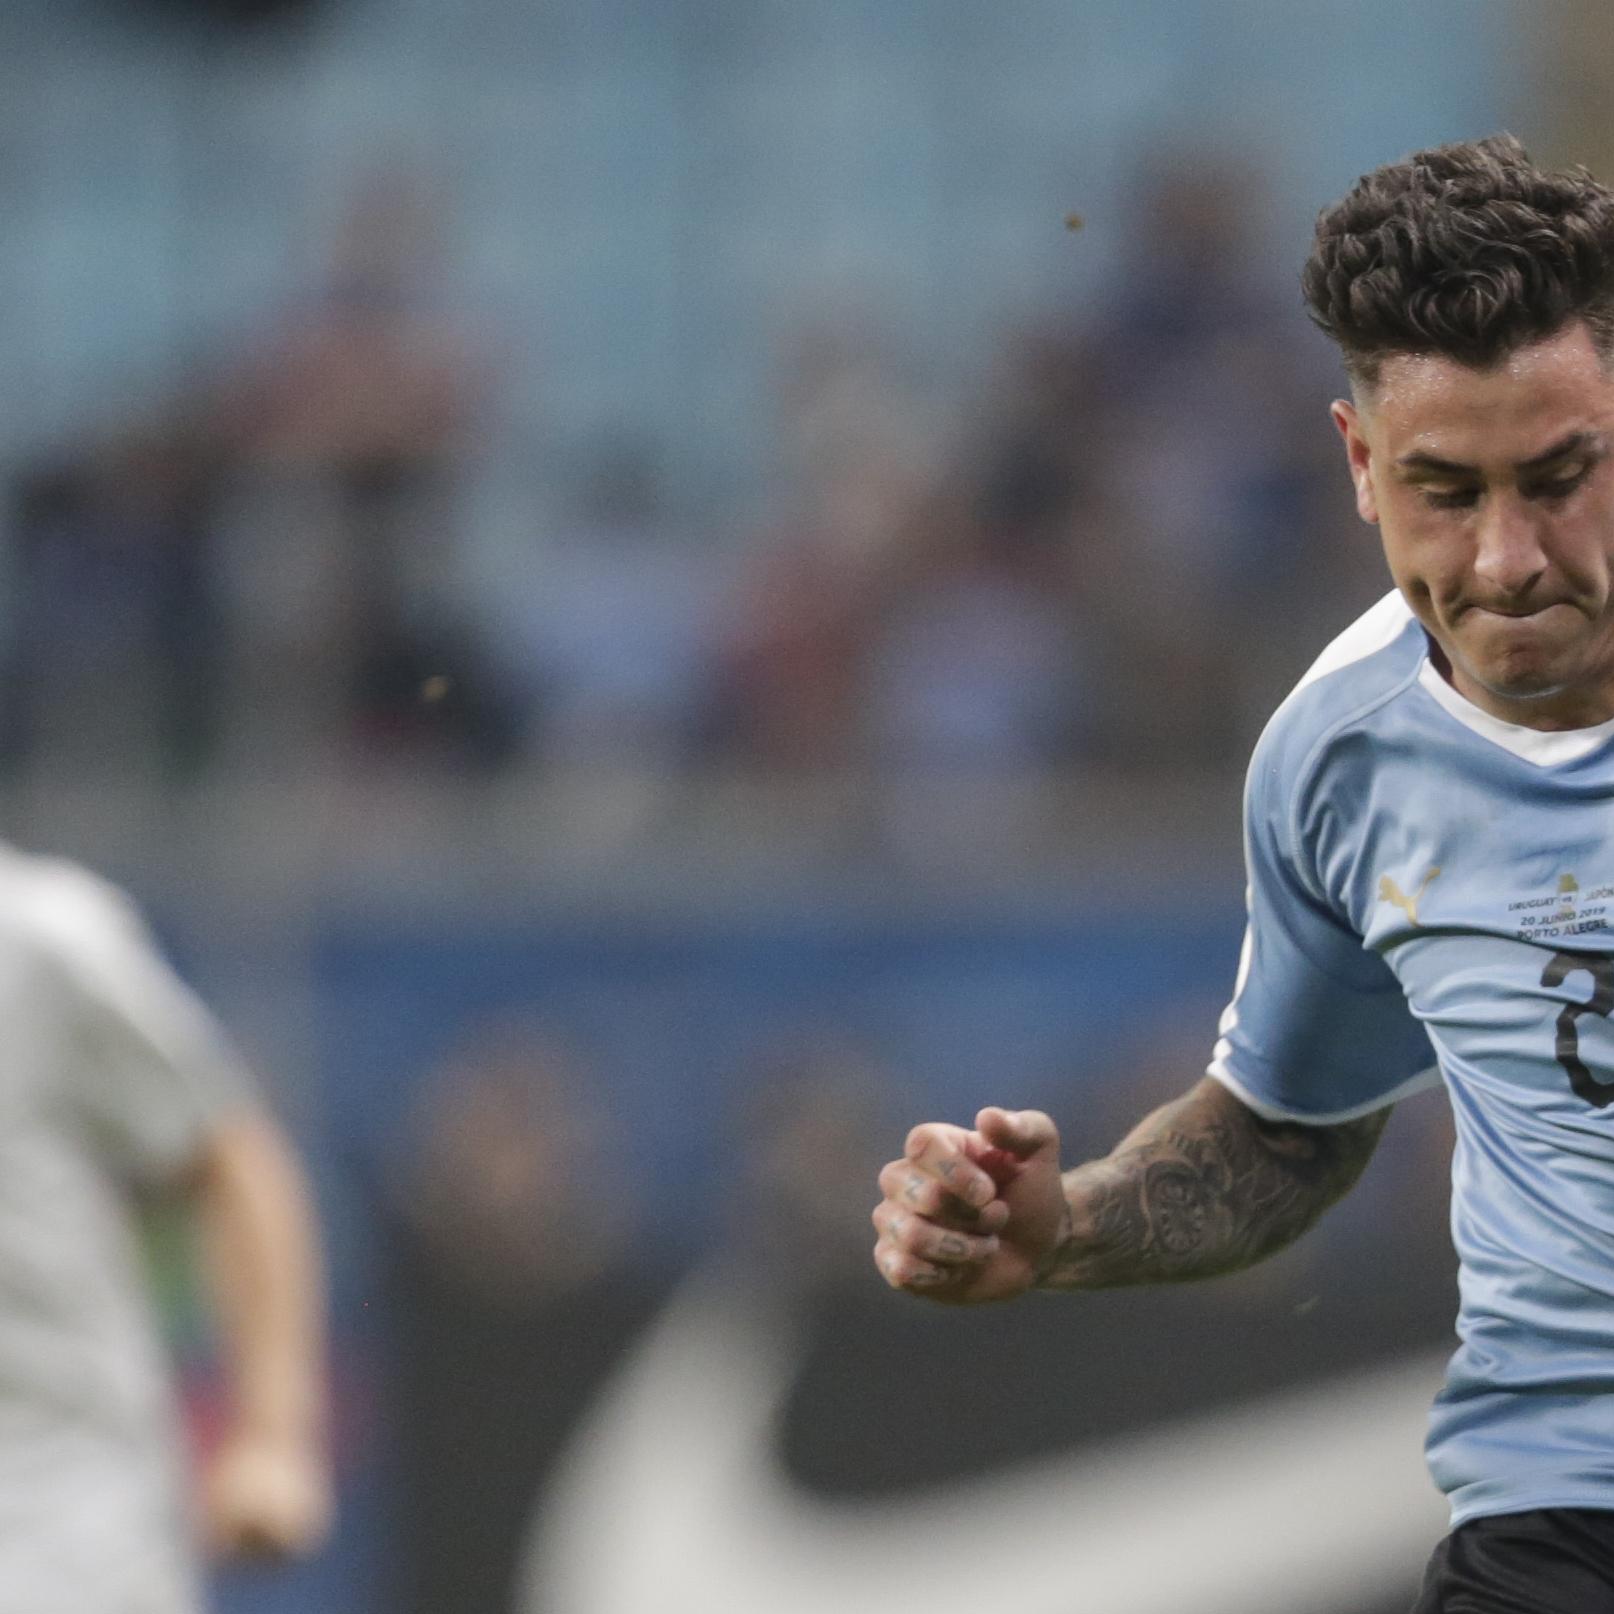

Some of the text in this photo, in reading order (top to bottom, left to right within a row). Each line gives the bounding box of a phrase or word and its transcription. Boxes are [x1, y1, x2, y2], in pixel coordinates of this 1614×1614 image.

[1508, 897, 1558, 912] URUGUAY
[1520, 917, 1535, 926] 20
[1579, 906, 1606, 919] 2019
[1517, 918, 1608, 941] PORTO ALEGRE
